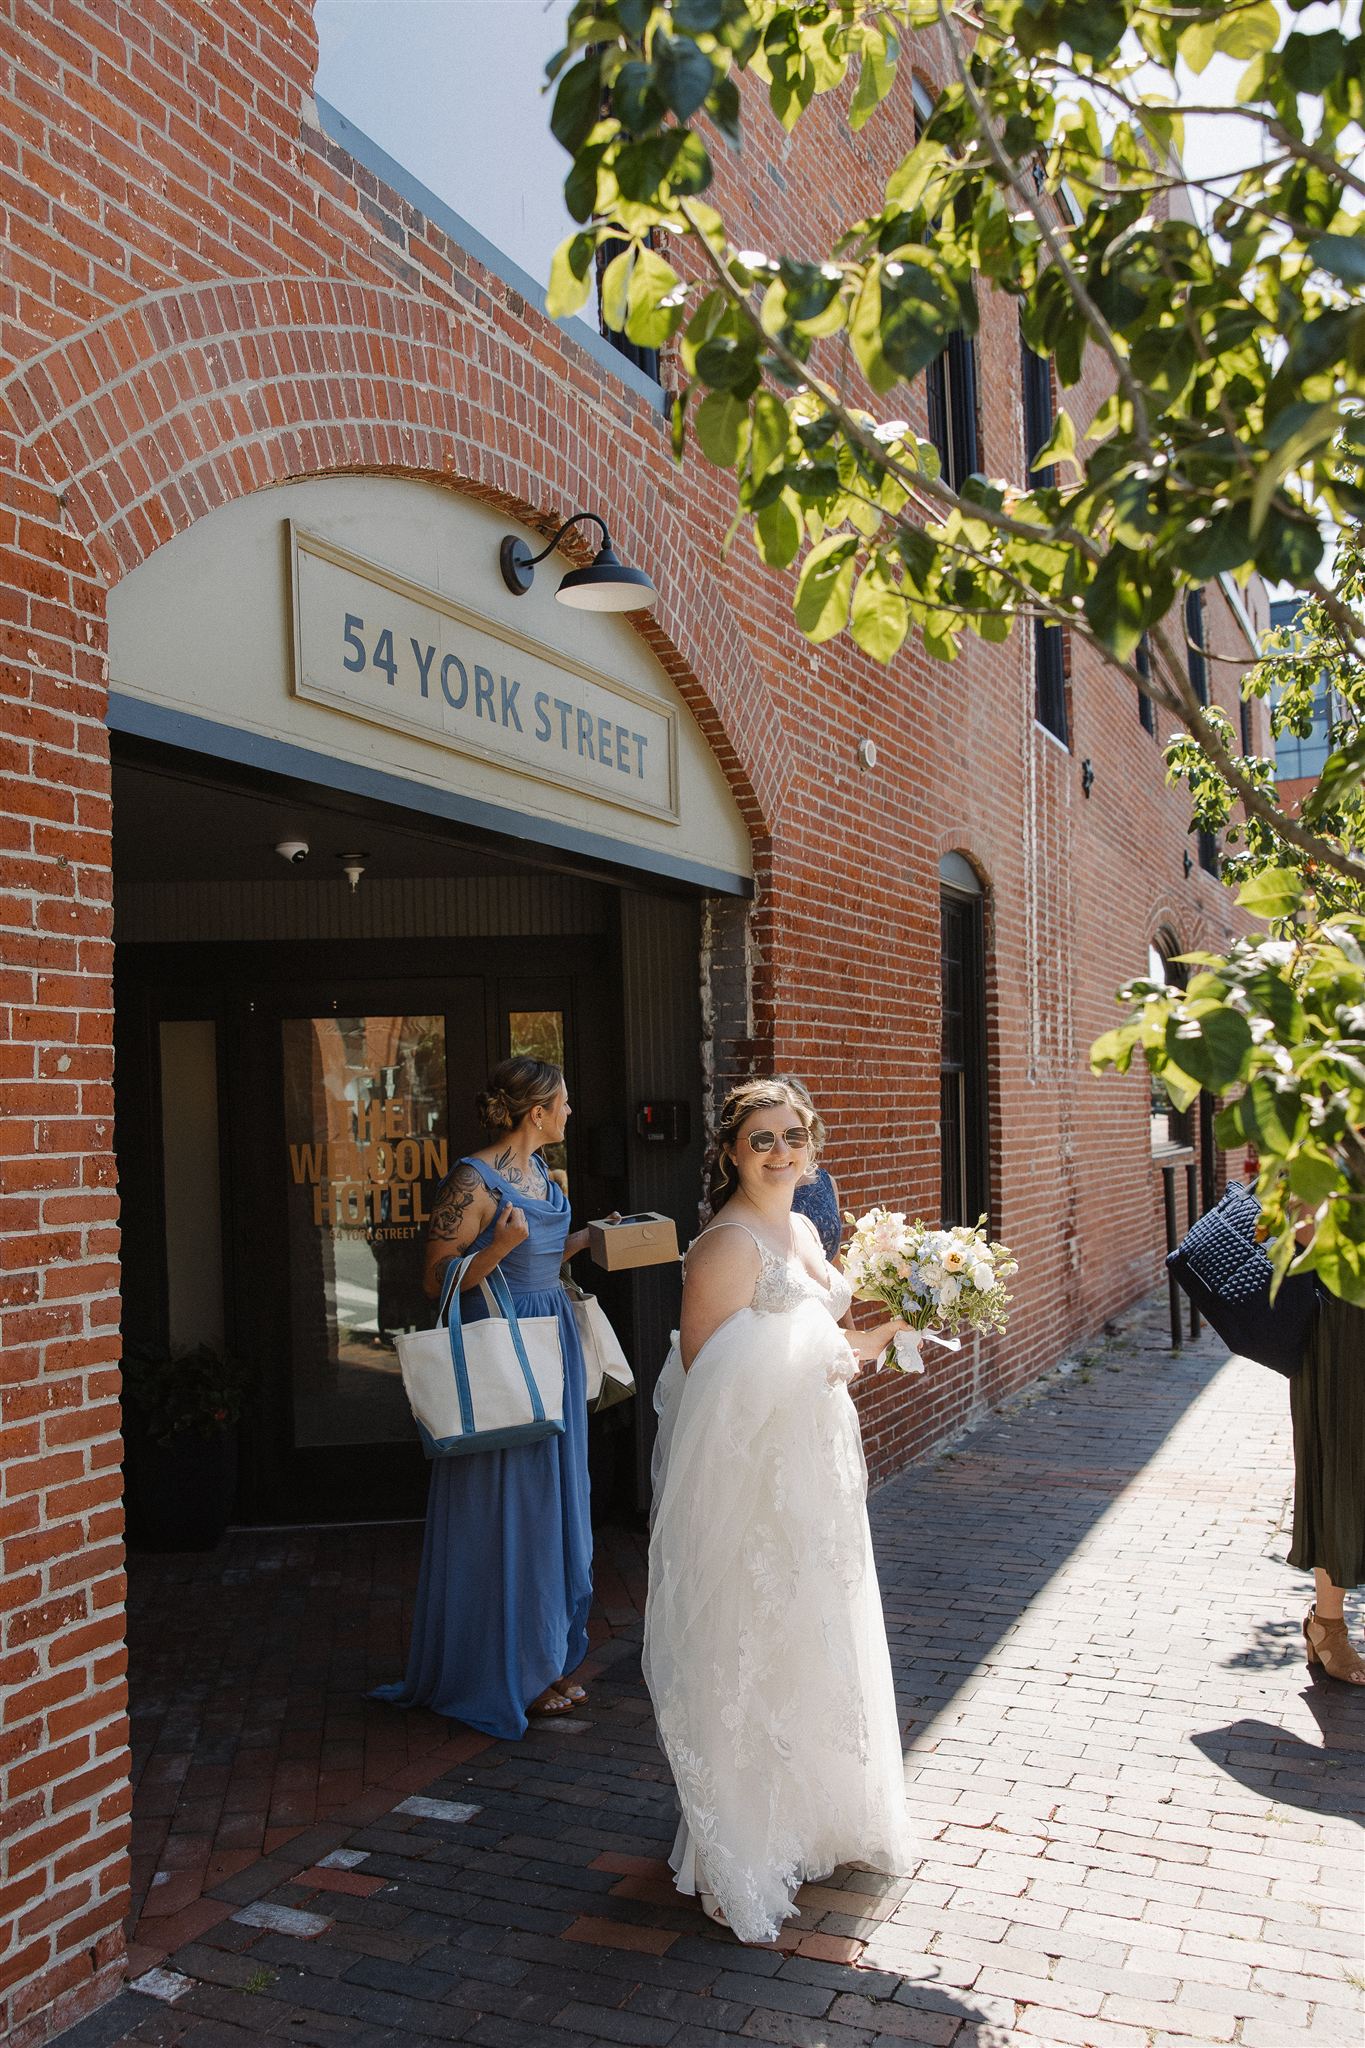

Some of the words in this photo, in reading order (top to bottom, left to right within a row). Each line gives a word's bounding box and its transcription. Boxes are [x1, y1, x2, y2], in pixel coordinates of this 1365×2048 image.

[343, 613, 398, 686] 54
[410, 638, 523, 733] YORK
[534, 692, 648, 779] STREET
[334, 1098, 404, 1140] THE
[313, 1183, 430, 1226] HOTEL
[329, 1229, 343, 1241] 54
[344, 1228, 374, 1241] YORK
[375, 1227, 416, 1240] STREET
